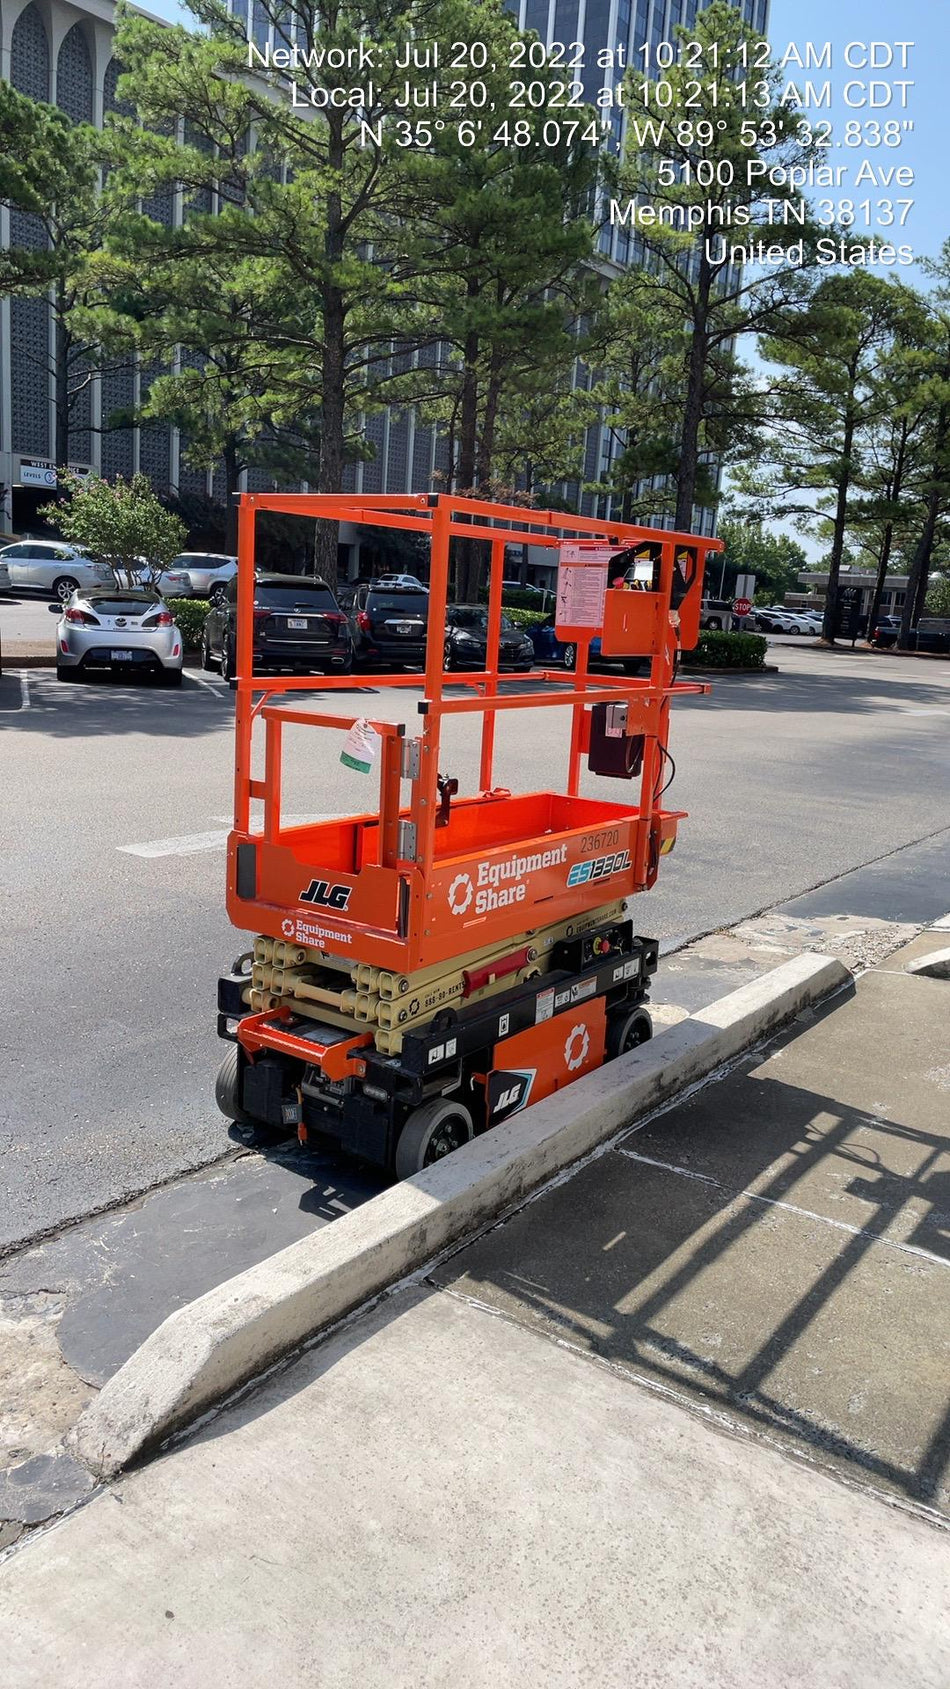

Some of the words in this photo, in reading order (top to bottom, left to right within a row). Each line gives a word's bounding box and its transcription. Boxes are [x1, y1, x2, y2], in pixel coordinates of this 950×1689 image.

[23, 471, 42, 479] LEVELS
[734, 602, 752, 611] STOP
[580, 830, 619, 853] 236720
[477, 844, 568, 887] Equipment
[567, 849, 633, 888] ES1330L
[298, 879, 353, 911] JLG
[475, 882, 527, 914] Share
[295, 931, 325, 948] Share
[296, 919, 353, 944] Equipment
[492, 1083, 522, 1113] JLG
